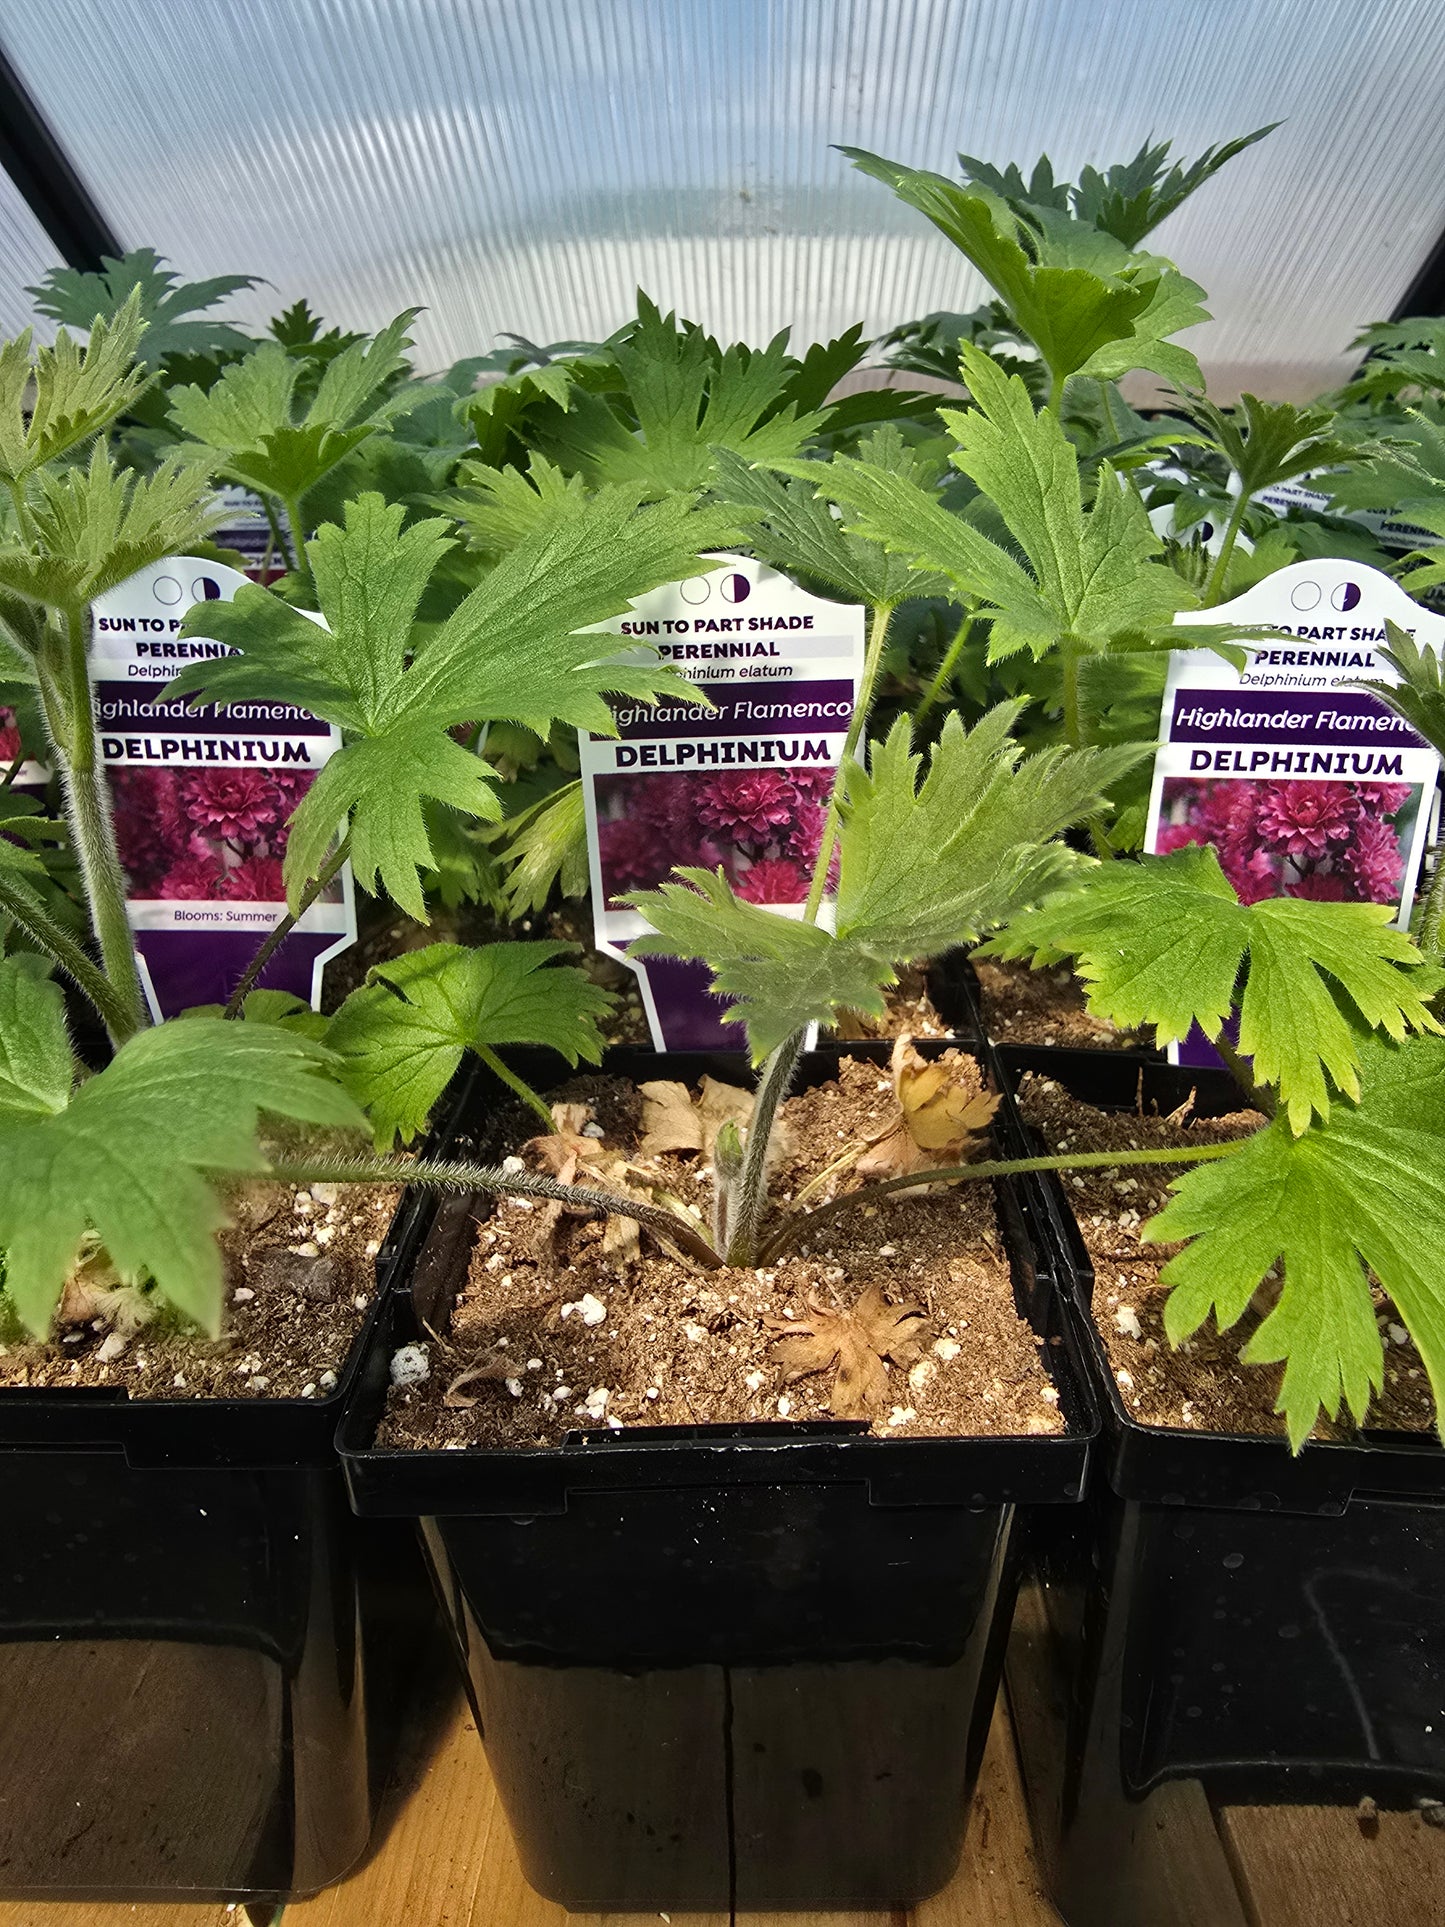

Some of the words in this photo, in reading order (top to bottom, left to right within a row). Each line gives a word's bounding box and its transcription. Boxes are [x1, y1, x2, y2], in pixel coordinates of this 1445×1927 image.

[1381, 521, 1444, 539] PERENN
[98, 617, 136, 632] SUN
[138, 618, 166, 632] TO
[621, 621, 660, 635] SUN
[663, 619, 689, 633] TO
[694, 617, 744, 633] PART
[748, 615, 814, 631] SHADE
[1297, 626, 1347, 640] PART
[1350, 627, 1416, 641] SHA
[136, 642, 241, 658] PERENNIA
[658, 641, 780, 660] PERENNIAL
[1254, 650, 1375, 667] PERENNIAL
[128, 664, 181, 678] Delphi
[680, 665, 735, 679] hinium
[740, 665, 793, 678] elatum
[1239, 672, 1327, 687] Delphinium
[92, 699, 209, 720] ighlander
[612, 703, 729, 727] ighlander
[733, 701, 851, 720] Flamenco
[1176, 708, 1313, 731] Highlander
[1315, 711, 1416, 732] Flamen
[102, 738, 311, 763] DELPHINIUM
[615, 739, 831, 768] DELPHINIUM
[1190, 750, 1404, 776] DELPHINIUM
[174, 910, 223, 921] Blooms:
[226, 910, 278, 922] Summer
